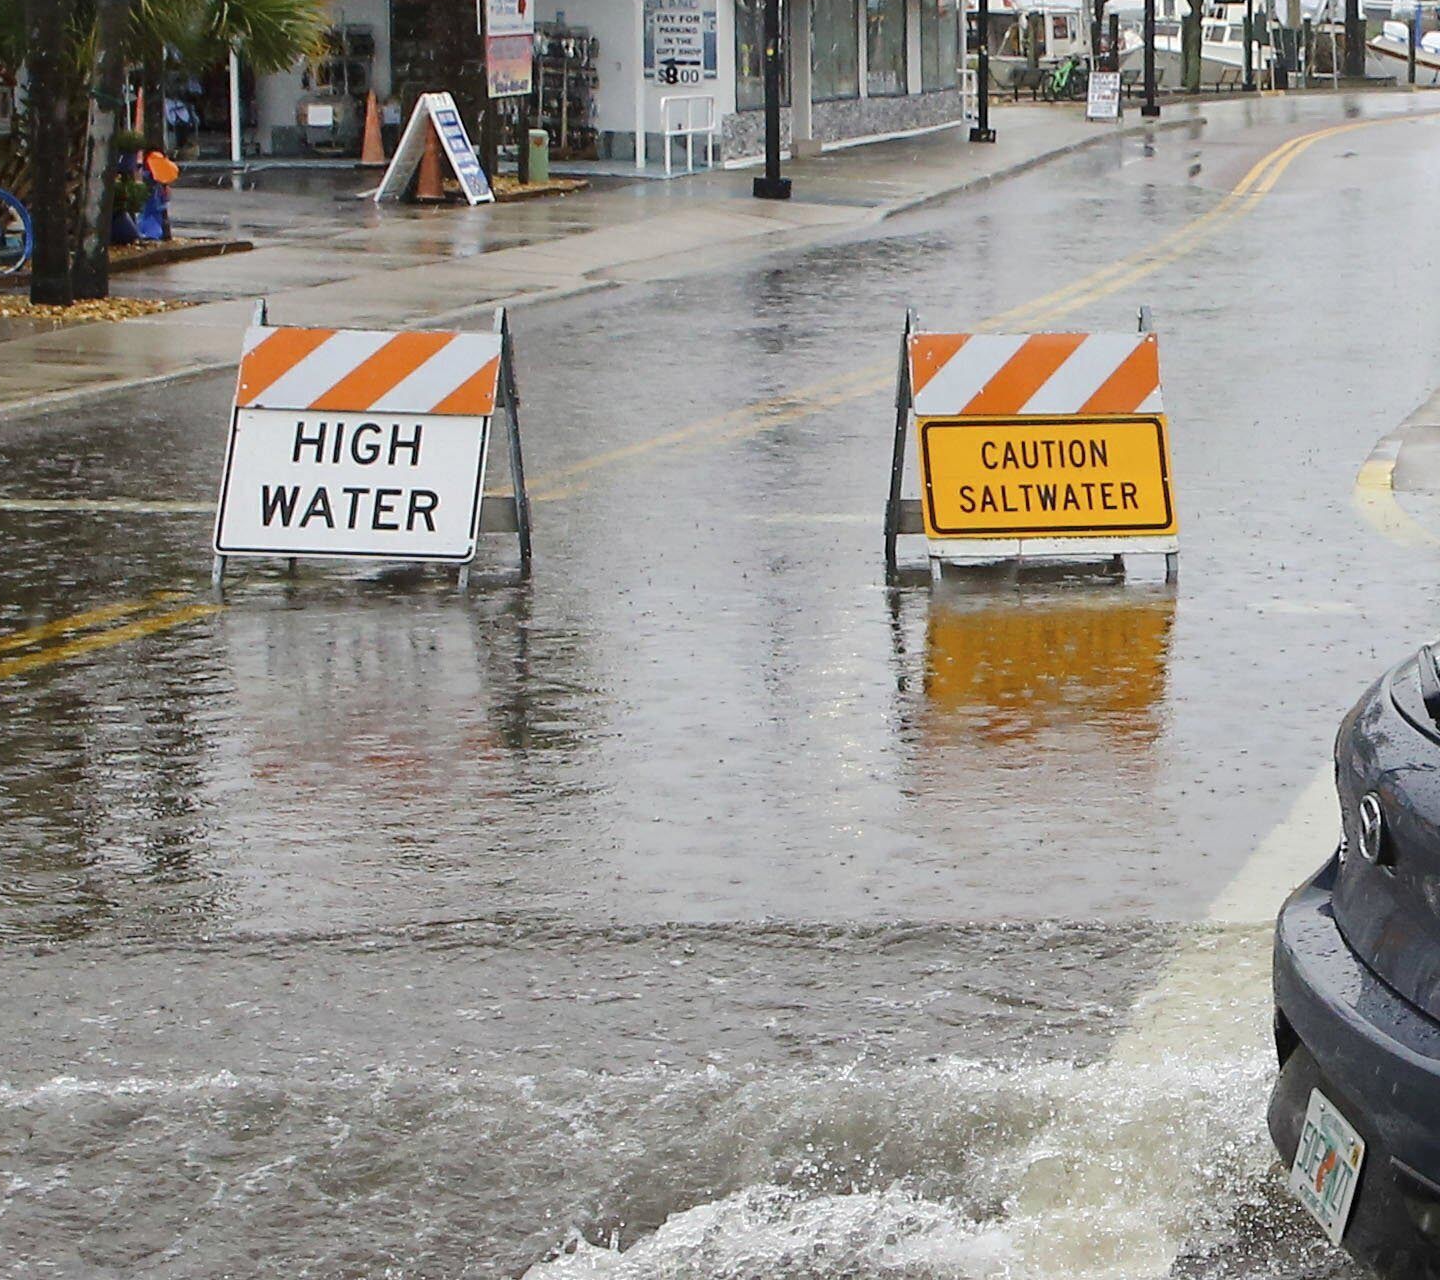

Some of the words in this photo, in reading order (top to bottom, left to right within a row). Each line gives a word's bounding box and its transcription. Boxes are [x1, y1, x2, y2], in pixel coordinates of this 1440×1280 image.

[657, 15, 675, 23] PAY
[680, 15, 700, 23] FOR
[291, 421, 423, 466] HIGH
[981, 439, 1109, 470] CAUTION
[261, 485, 440, 532] WATER
[959, 482, 1139, 513] SALTWATER
